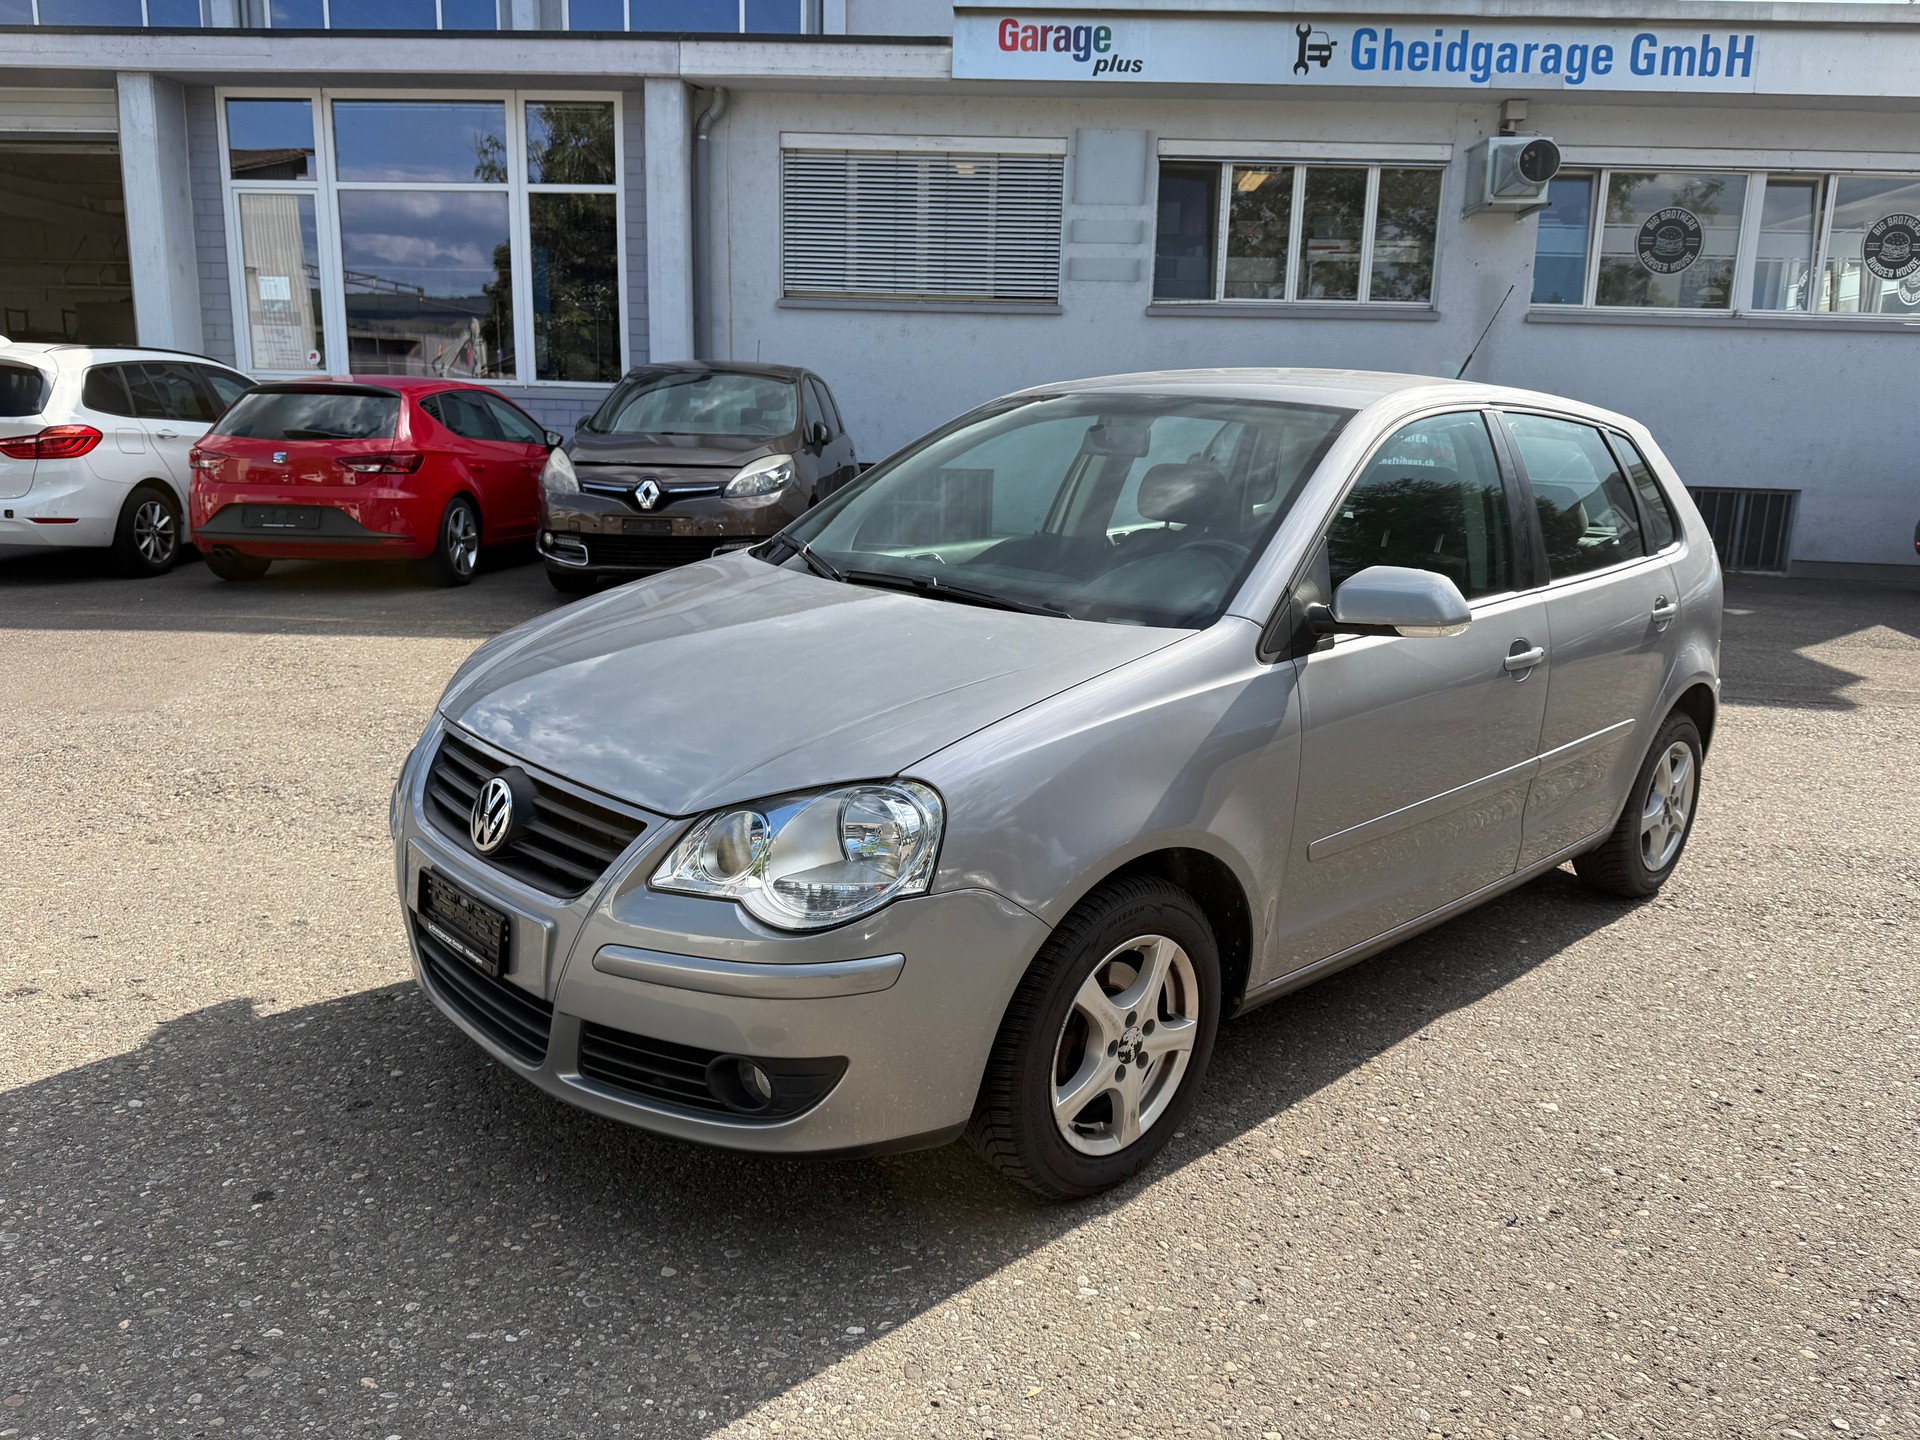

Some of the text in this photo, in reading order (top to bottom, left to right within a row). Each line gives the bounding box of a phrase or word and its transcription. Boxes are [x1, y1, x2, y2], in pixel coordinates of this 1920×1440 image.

[998, 17, 1112, 63] Garage
[1092, 54, 1143, 77] plus
[1350, 26, 1756, 85] Gheidgarage GmbH
[1645, 209, 1698, 231] BIG BROTHERS
[1872, 221, 1887, 236] BIG
[1641, 250, 1695, 273] BURGER HOUSE
[1866, 256, 1920, 278] BURGER HOUSE
